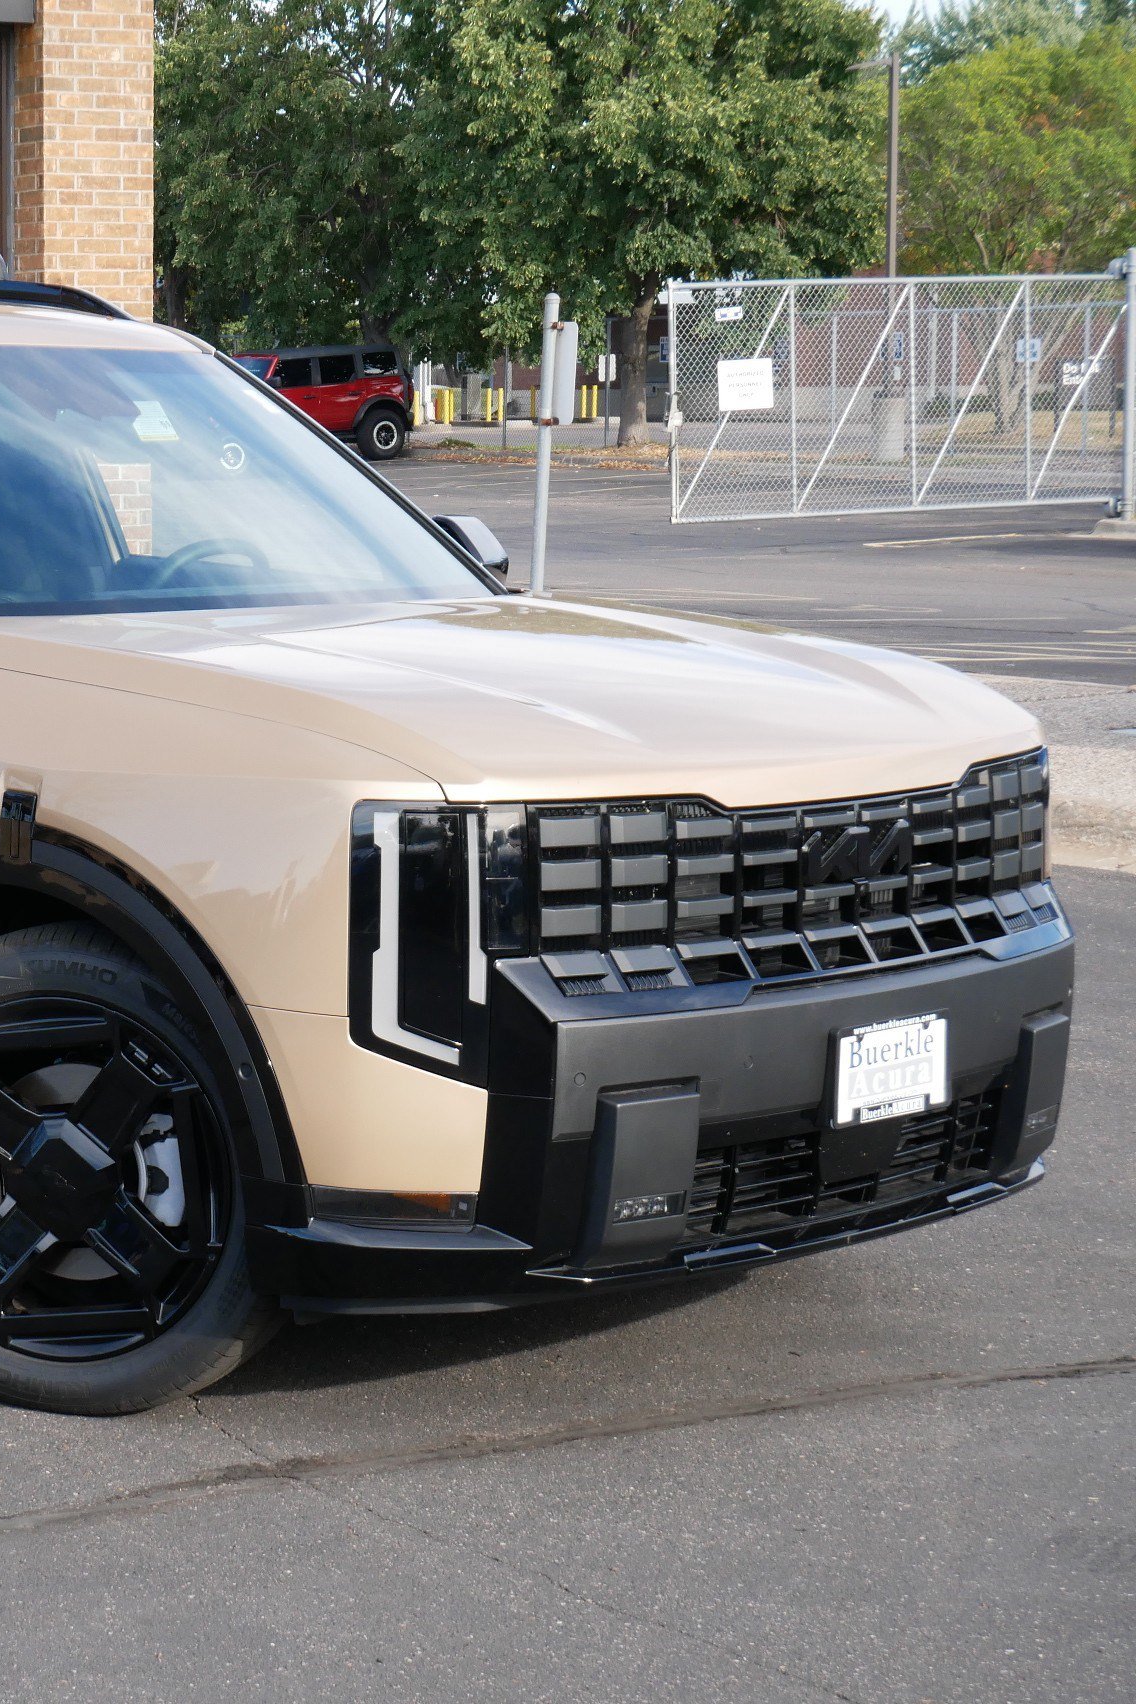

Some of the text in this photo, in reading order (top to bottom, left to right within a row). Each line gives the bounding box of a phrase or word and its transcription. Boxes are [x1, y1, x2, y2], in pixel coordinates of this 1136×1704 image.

[853, 1013, 937, 1035] www.buerkleacura.com
[849, 1028, 934, 1069] Buerkle
[850, 1061, 932, 1098] Acura
[863, 1101, 893, 1120] Buerkle
